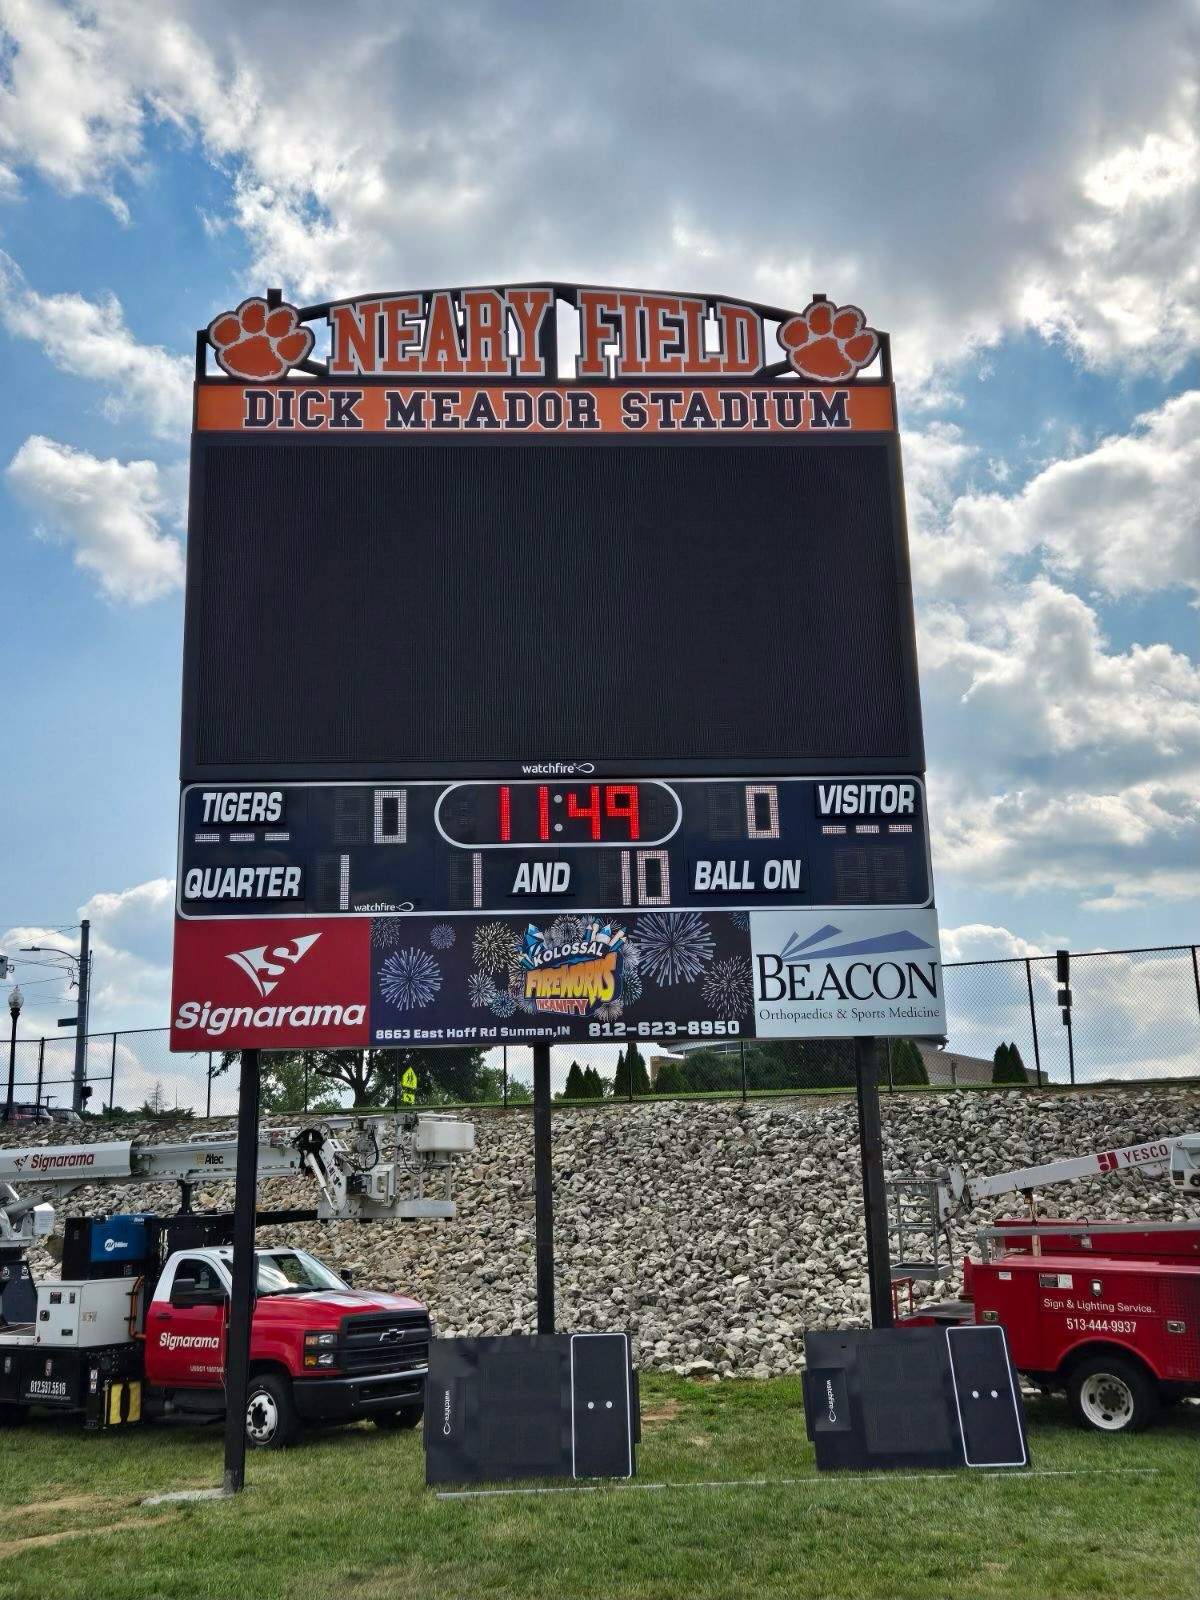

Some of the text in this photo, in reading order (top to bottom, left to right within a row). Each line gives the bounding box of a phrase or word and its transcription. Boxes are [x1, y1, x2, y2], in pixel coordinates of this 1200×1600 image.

[329, 288, 765, 378] NEARY FIELD
[243, 389, 851, 431] DICK MEADOR STADIUM
[521, 762, 575, 774] watchfire
[202, 790, 284, 823] TIGERS
[498, 784, 640, 842] 11:49
[745, 784, 780, 839] 0
[818, 784, 915, 815] VISITOR
[373, 789, 408, 844] 0
[183, 865, 302, 900] QUARTER
[339, 854, 350, 910] 1
[512, 861, 571, 893] AND
[620, 850, 671, 906] 10
[694, 858, 802, 891] BALL ON
[354, 901, 396, 912] watchfire
[533, 941, 604, 968] KOLOSSAL
[524, 951, 618, 1008] FIREWORKS
[755, 953, 938, 1002] BEACON
[175, 1000, 366, 1036] Signarama
[588, 1021, 741, 1037] 812-623-8950
[759, 1006, 940, 1023] Orthopaedics & Sports Medicine
[375, 1028, 411, 1039] 8663
[413, 1028, 444, 1039] East
[446, 1027, 477, 1038] Hoff
[479, 1026, 497, 1038] Rd
[31, 1153, 95, 1172] Signarama
[1123, 1144, 1168, 1163] YESCO
[1043, 1298, 1064, 1310] Sign
[1066, 1299, 1075, 1309] &
[1076, 1300, 1115, 1313] Lighting
[159, 1332, 220, 1351] Signarama
[1066, 1317, 1137, 1333] 513-444-9937
